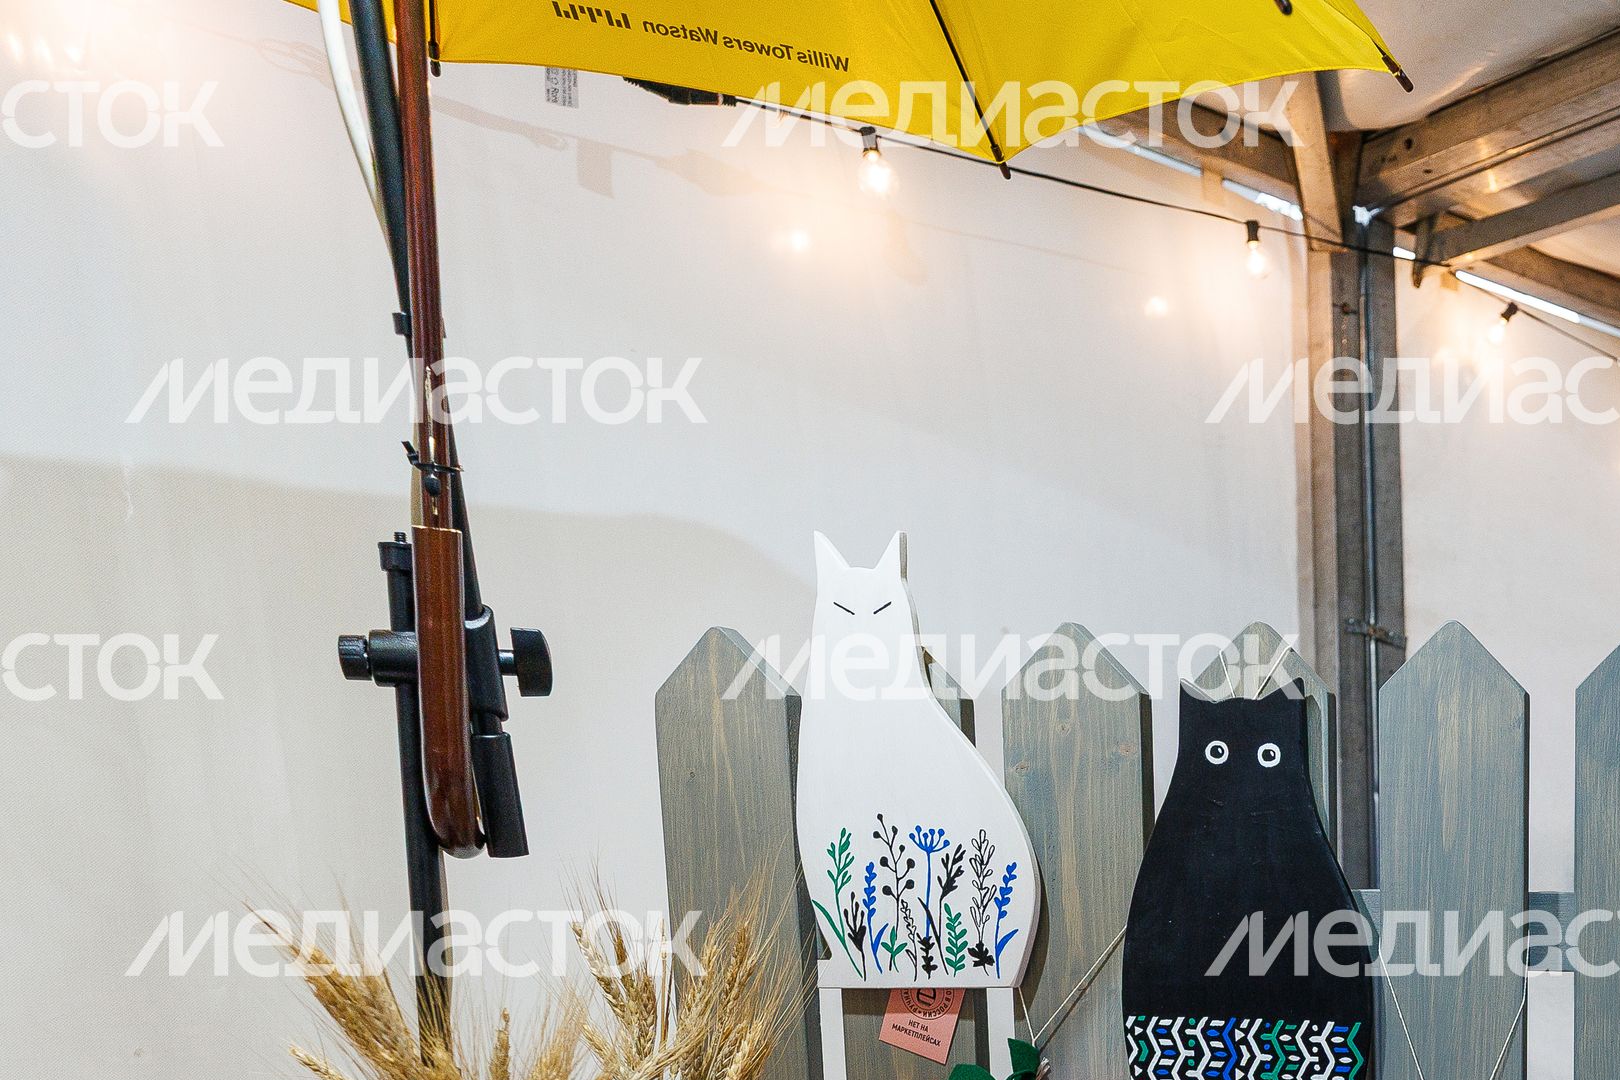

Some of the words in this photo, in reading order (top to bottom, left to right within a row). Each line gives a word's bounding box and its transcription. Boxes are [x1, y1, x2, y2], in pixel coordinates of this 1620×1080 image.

[891, 1023, 942, 1047] МАРКЕТПЛЕЙСАХ
[908, 1019, 920, 1029] НЕТ
[920, 1023, 929, 1033] НА
